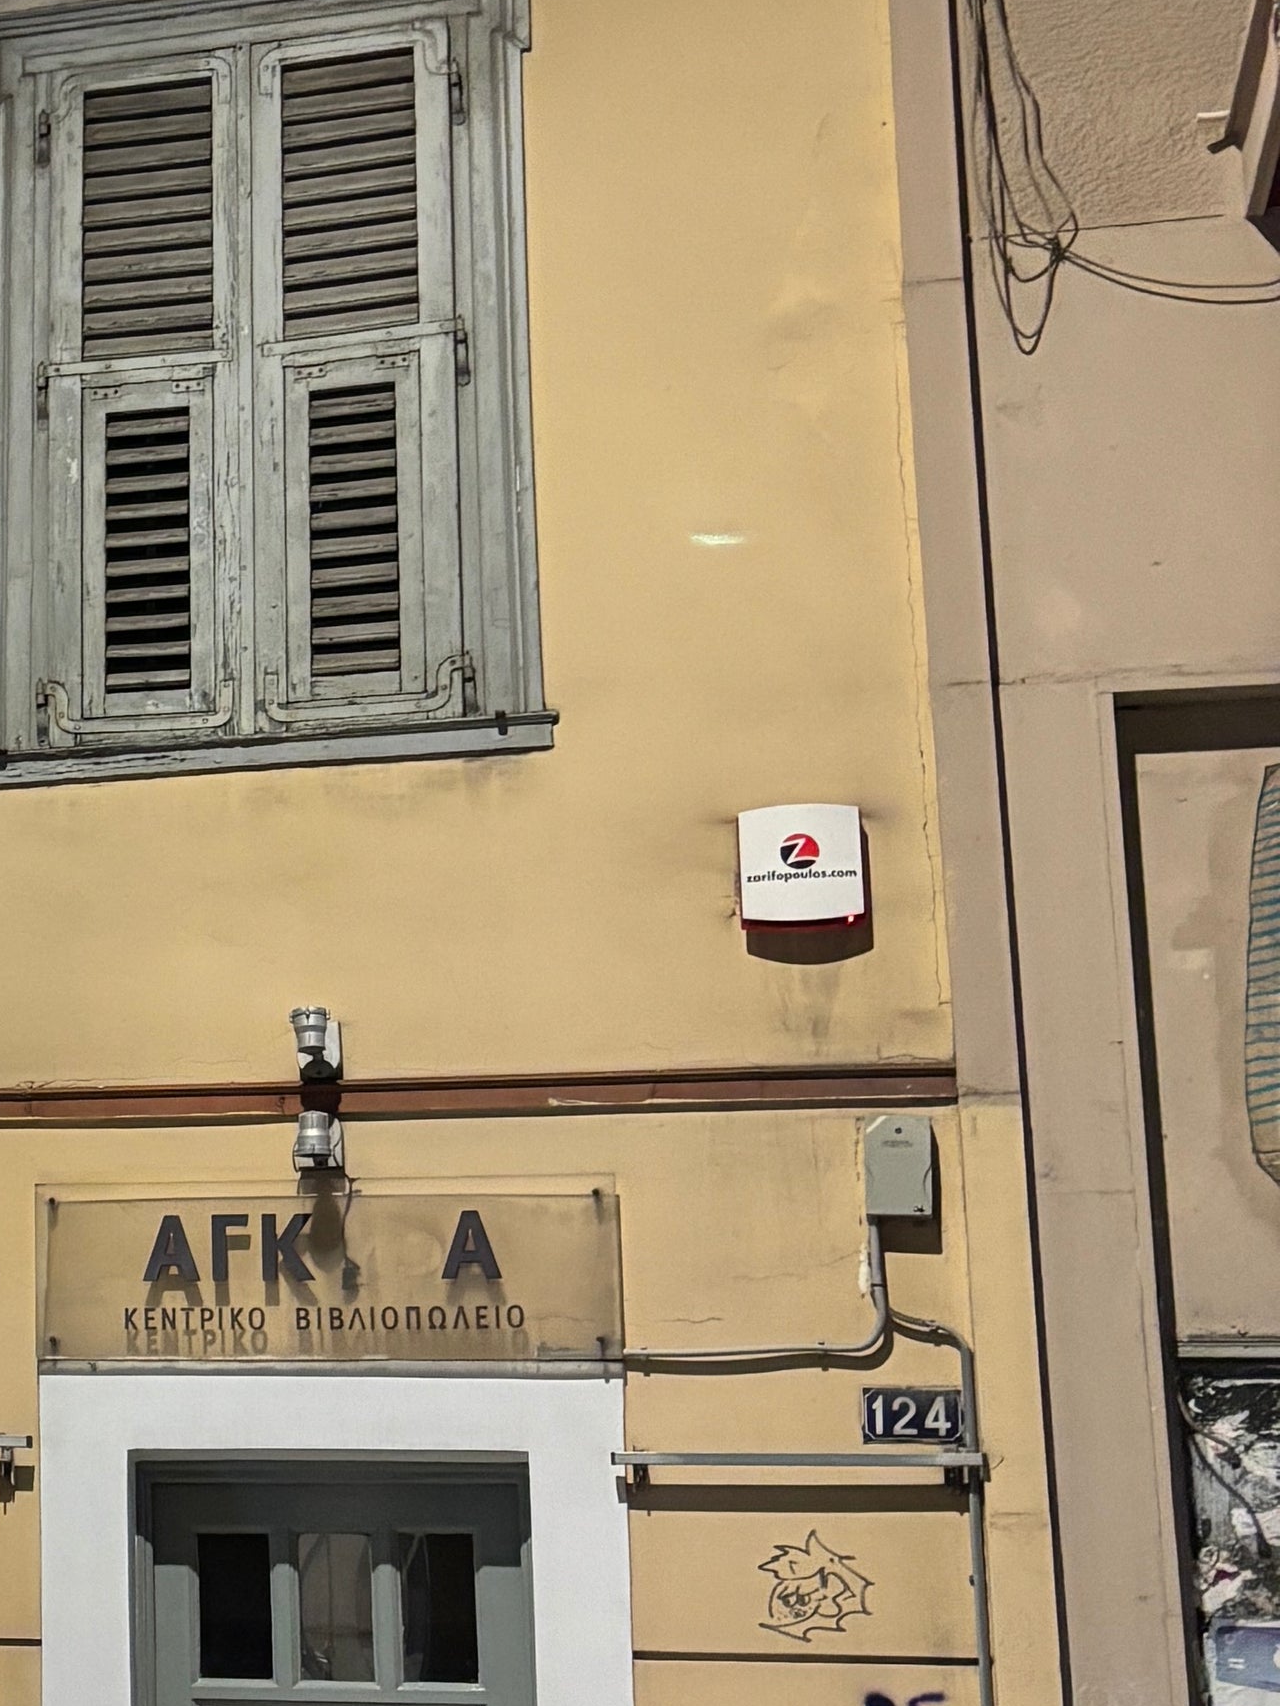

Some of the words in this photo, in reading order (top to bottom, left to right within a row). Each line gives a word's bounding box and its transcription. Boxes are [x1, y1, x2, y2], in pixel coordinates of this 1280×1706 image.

[746, 868, 857, 883] zarifopoulos.com
[123, 1306, 267, 1332] ΚΕΝΤΡΙΚΟ
[295, 1304, 526, 1332] ΒΙΒΛΙΟΠΩΛΕΙΟ
[871, 1394, 952, 1437] 124
